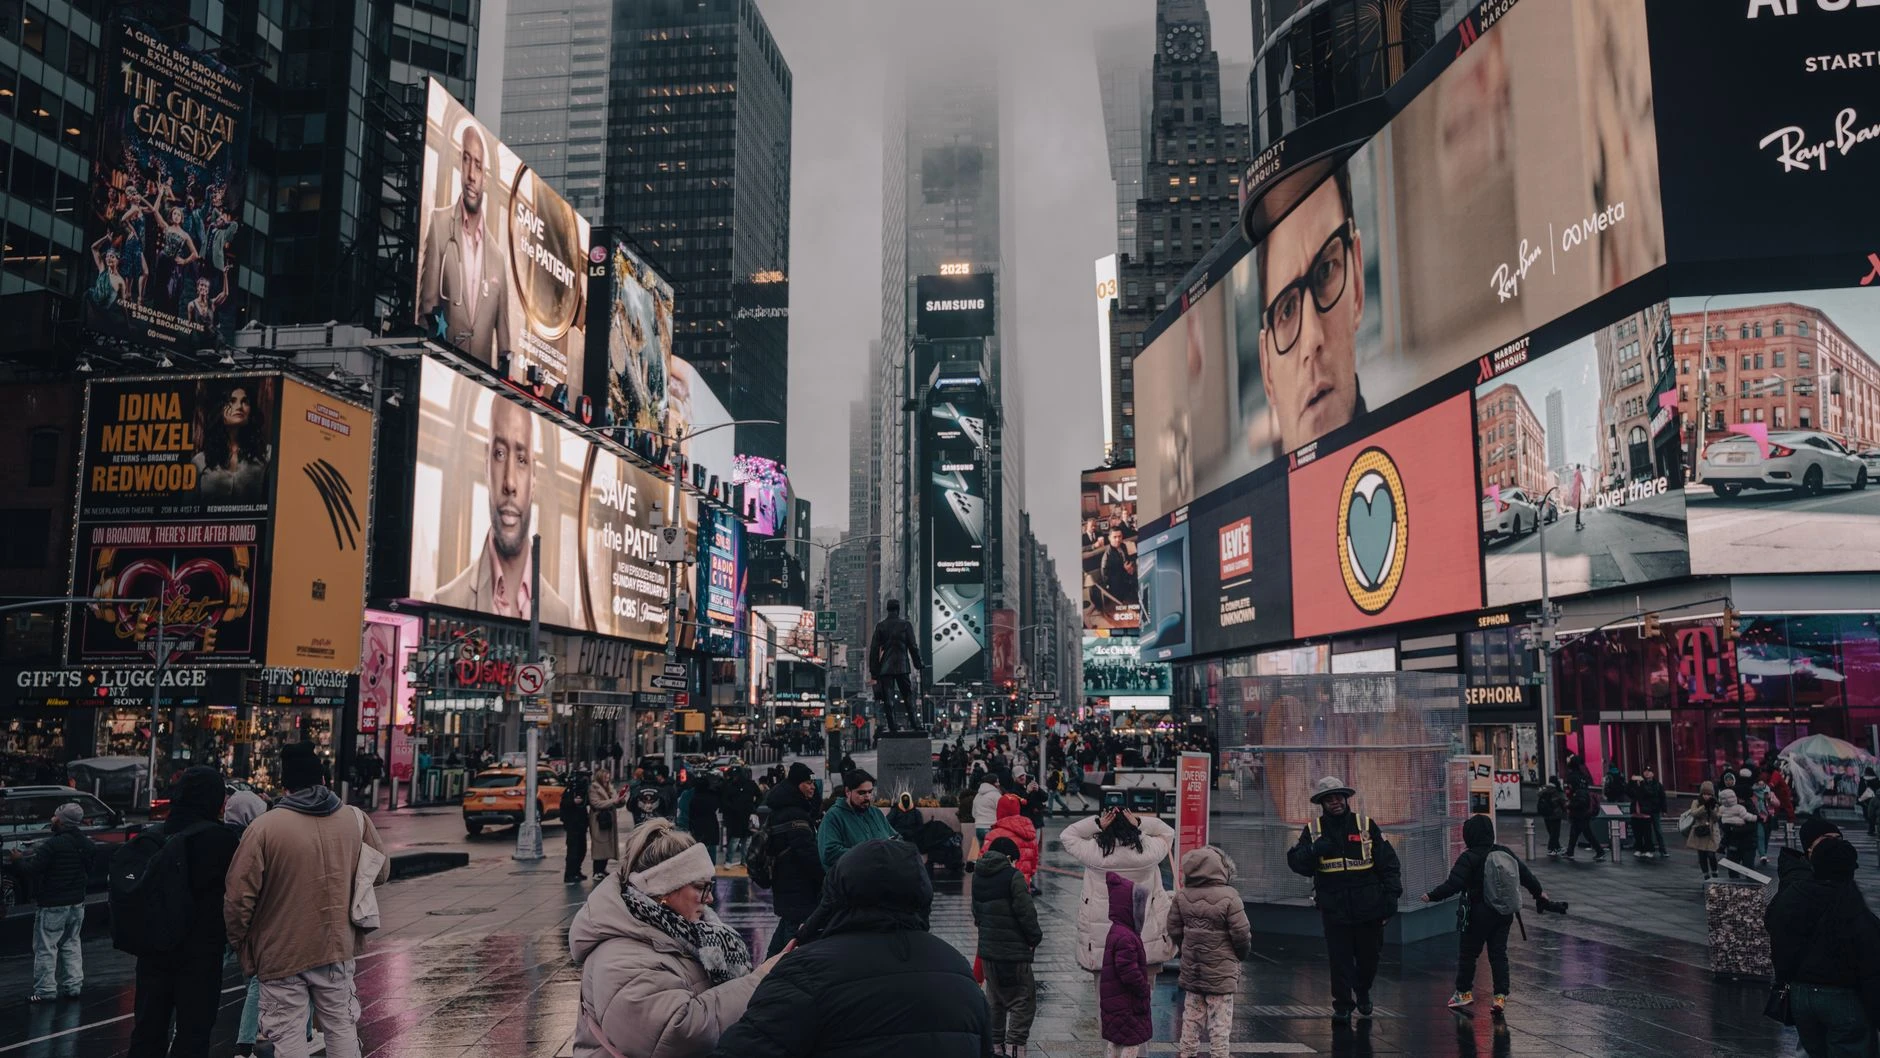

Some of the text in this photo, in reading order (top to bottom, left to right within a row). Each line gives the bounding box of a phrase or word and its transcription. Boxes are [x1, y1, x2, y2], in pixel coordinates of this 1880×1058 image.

[135, 31, 170, 57] GREAT,
[172, 50, 190, 66] BIG
[192, 60, 243, 93] BROADWAY
[147, 48, 222, 94] EXTRAVAGANZA
[122, 47, 139, 60] THAT
[140, 56, 173, 78] EXPLODES
[175, 74, 190, 86] WITH
[191, 82, 203, 93] LIFE
[204, 90, 217, 100] AND
[123, 69, 236, 144] THE GREAT
[133, 104, 223, 161] GATSBY
[147, 137, 207, 168] A NEW MUSICAL
[1246, 140, 1286, 178] MARRIOTT
[1247, 159, 1280, 194] MARQUIS
[517, 203, 544, 240] SAVE
[1583, 202, 1625, 240] Meta
[520, 236, 575, 288] the PATIENT
[590, 266, 605, 276] LG
[940, 264, 969, 275] 2025
[1096, 279, 1116, 299] 03
[1188, 272, 1209, 294] MARRIOTT
[1190, 284, 1207, 304] MARQUIS
[926, 299, 984, 312] SAMSUNG
[138, 305, 175, 322] BROADWAY
[177, 317, 204, 331] THEATRE
[156, 318, 192, 335] BROADWAY
[1494, 336, 1530, 361] MARRIOTT
[1495, 351, 1527, 373] MARQUIS
[118, 392, 181, 421] IDINA
[101, 423, 194, 452] MENZEL
[148, 454, 179, 462] BROADWAY
[92, 462, 196, 492] REDWOOD
[600, 474, 636, 518] SAVE
[1596, 476, 1667, 509] over there
[207, 504, 268, 512] REDWOODMUSICAL.COM
[92, 524, 256, 544] ON BROADWAY, THERE'S LIFE AFTER ROMEO
[603, 522, 622, 552] the
[1222, 523, 1249, 560] LEVI'S
[712, 555, 733, 575] RADIO
[612, 574, 636, 591] SUNDAY
[636, 578, 662, 597] FEBRUARY
[712, 570, 733, 589] CITY
[622, 596, 636, 618] CBS
[1221, 607, 1255, 626] UNKNOWN
[1478, 612, 1510, 628] SEPHORA
[17, 671, 82, 687] GIFTS
[261, 668, 348, 688] GIFTS LUGGAGE
[110, 688, 127, 696] NY
[1464, 686, 1522, 704] SEPHORA
[1187, 782, 1202, 792] AFTER
